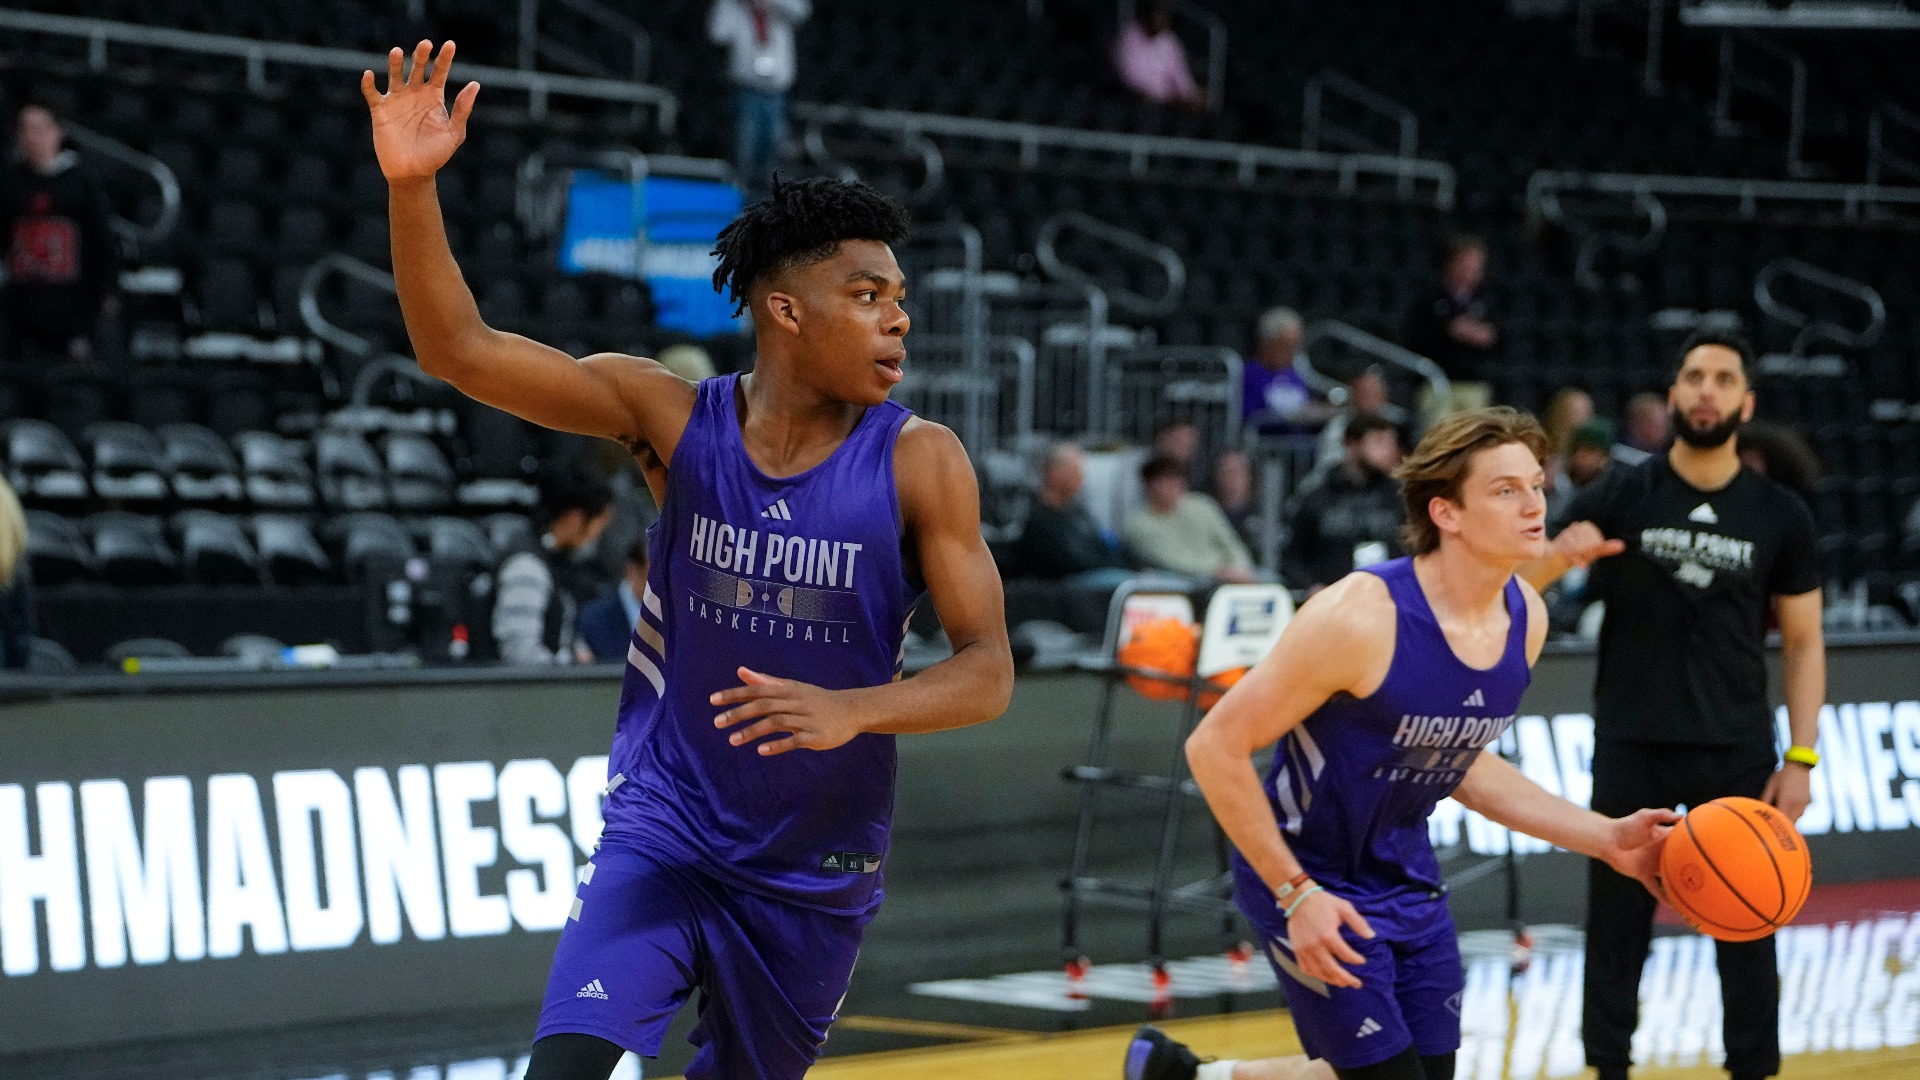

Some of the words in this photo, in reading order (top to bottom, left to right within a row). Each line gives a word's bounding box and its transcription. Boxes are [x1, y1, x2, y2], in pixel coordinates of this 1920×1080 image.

[690, 513, 758, 575] HIGH
[763, 533, 863, 588] POINT
[689, 596, 850, 643] BASKETBALL
[1392, 714, 1460, 748] HIGH
[849, 861, 858, 869] XL
[576, 990, 609, 1000] adidas
